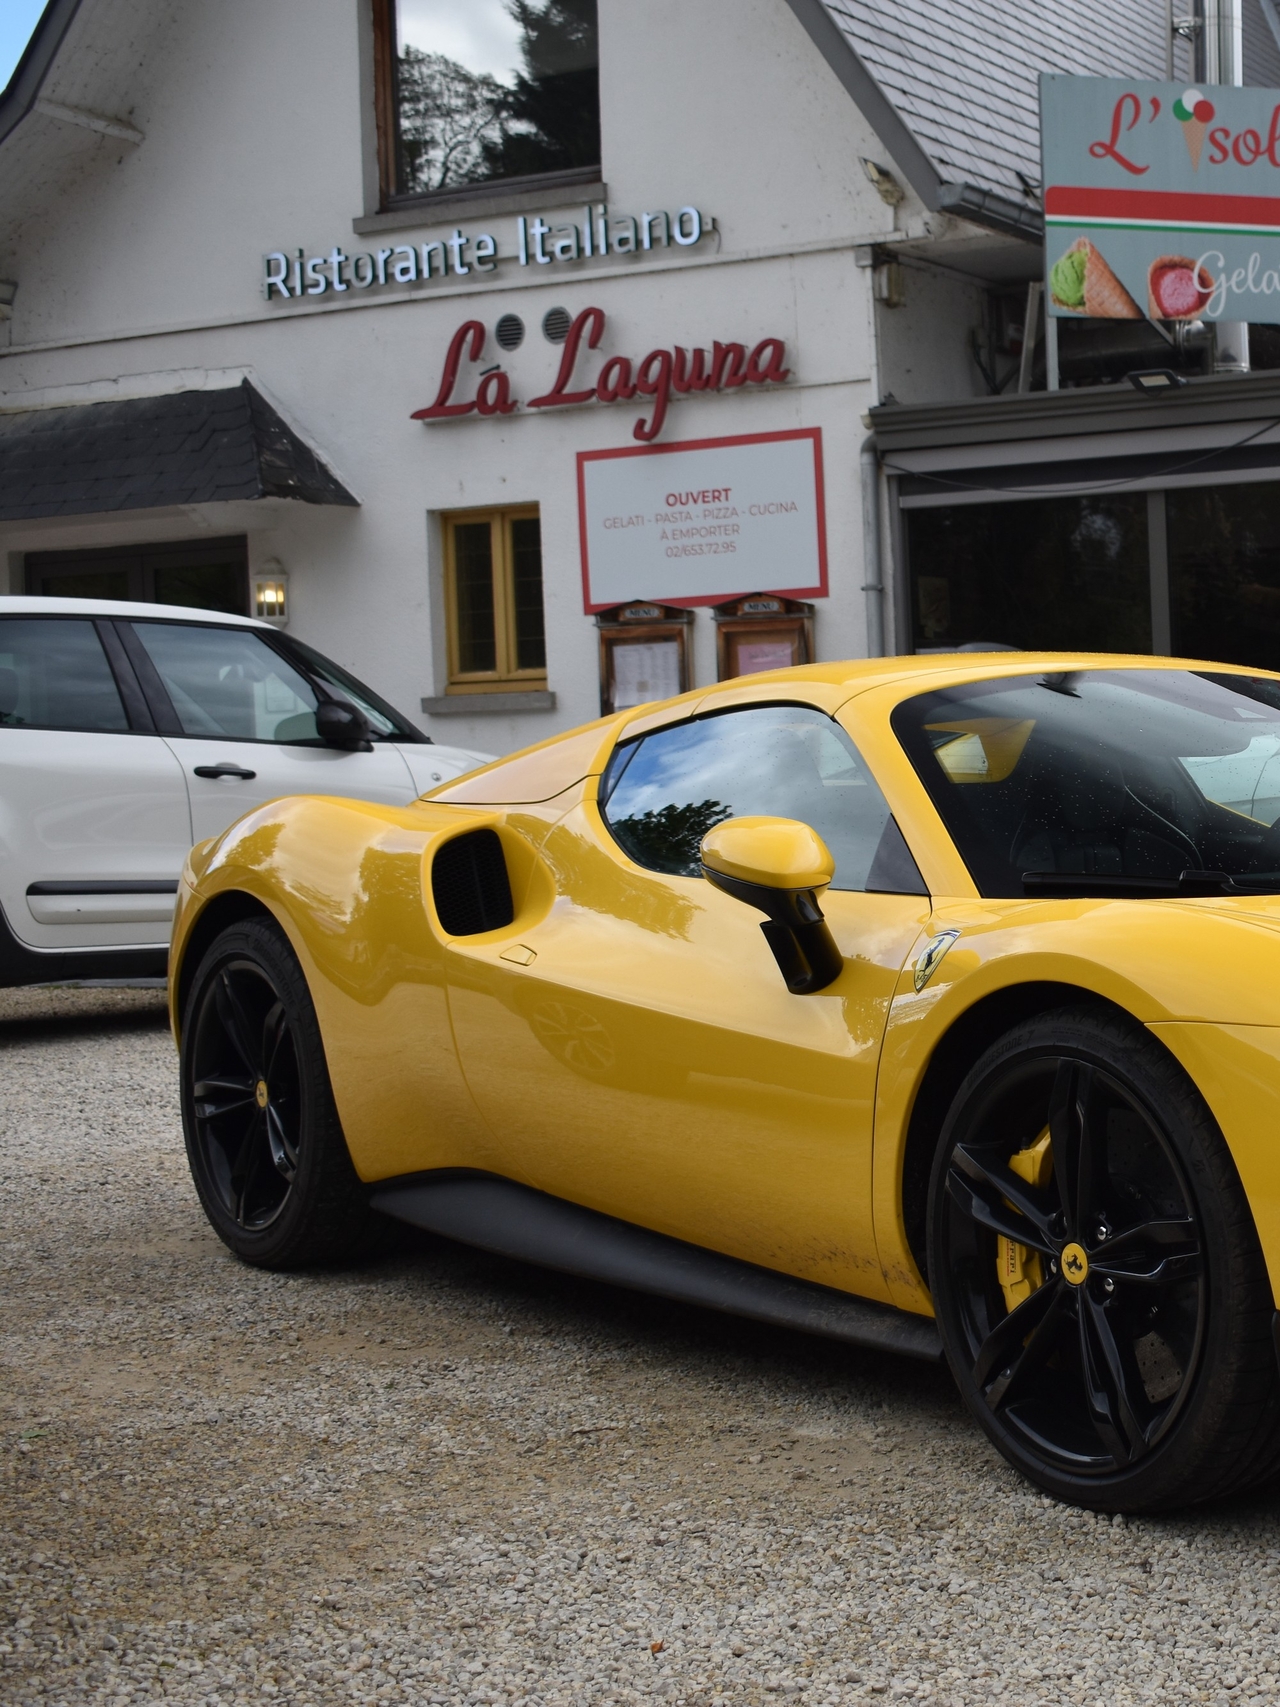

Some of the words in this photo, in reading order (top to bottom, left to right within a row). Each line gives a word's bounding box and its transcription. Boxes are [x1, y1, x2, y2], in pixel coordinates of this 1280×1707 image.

[263, 229, 497, 301] Ristorante
[517, 203, 703, 266] Italiano
[526, 306, 791, 442] Laguna
[665, 487, 732, 507] OUVERT
[603, 515, 644, 530] GELATI
[655, 511, 694, 525] PASTA
[703, 507, 740, 520] PIZZA
[749, 501, 799, 516] CUCINA
[672, 524, 740, 540] EMPORTER
[665, 541, 737, 558] 02/653.72.95
[629, 609, 656, 618] MENU
[748, 602, 775, 611] MENU
